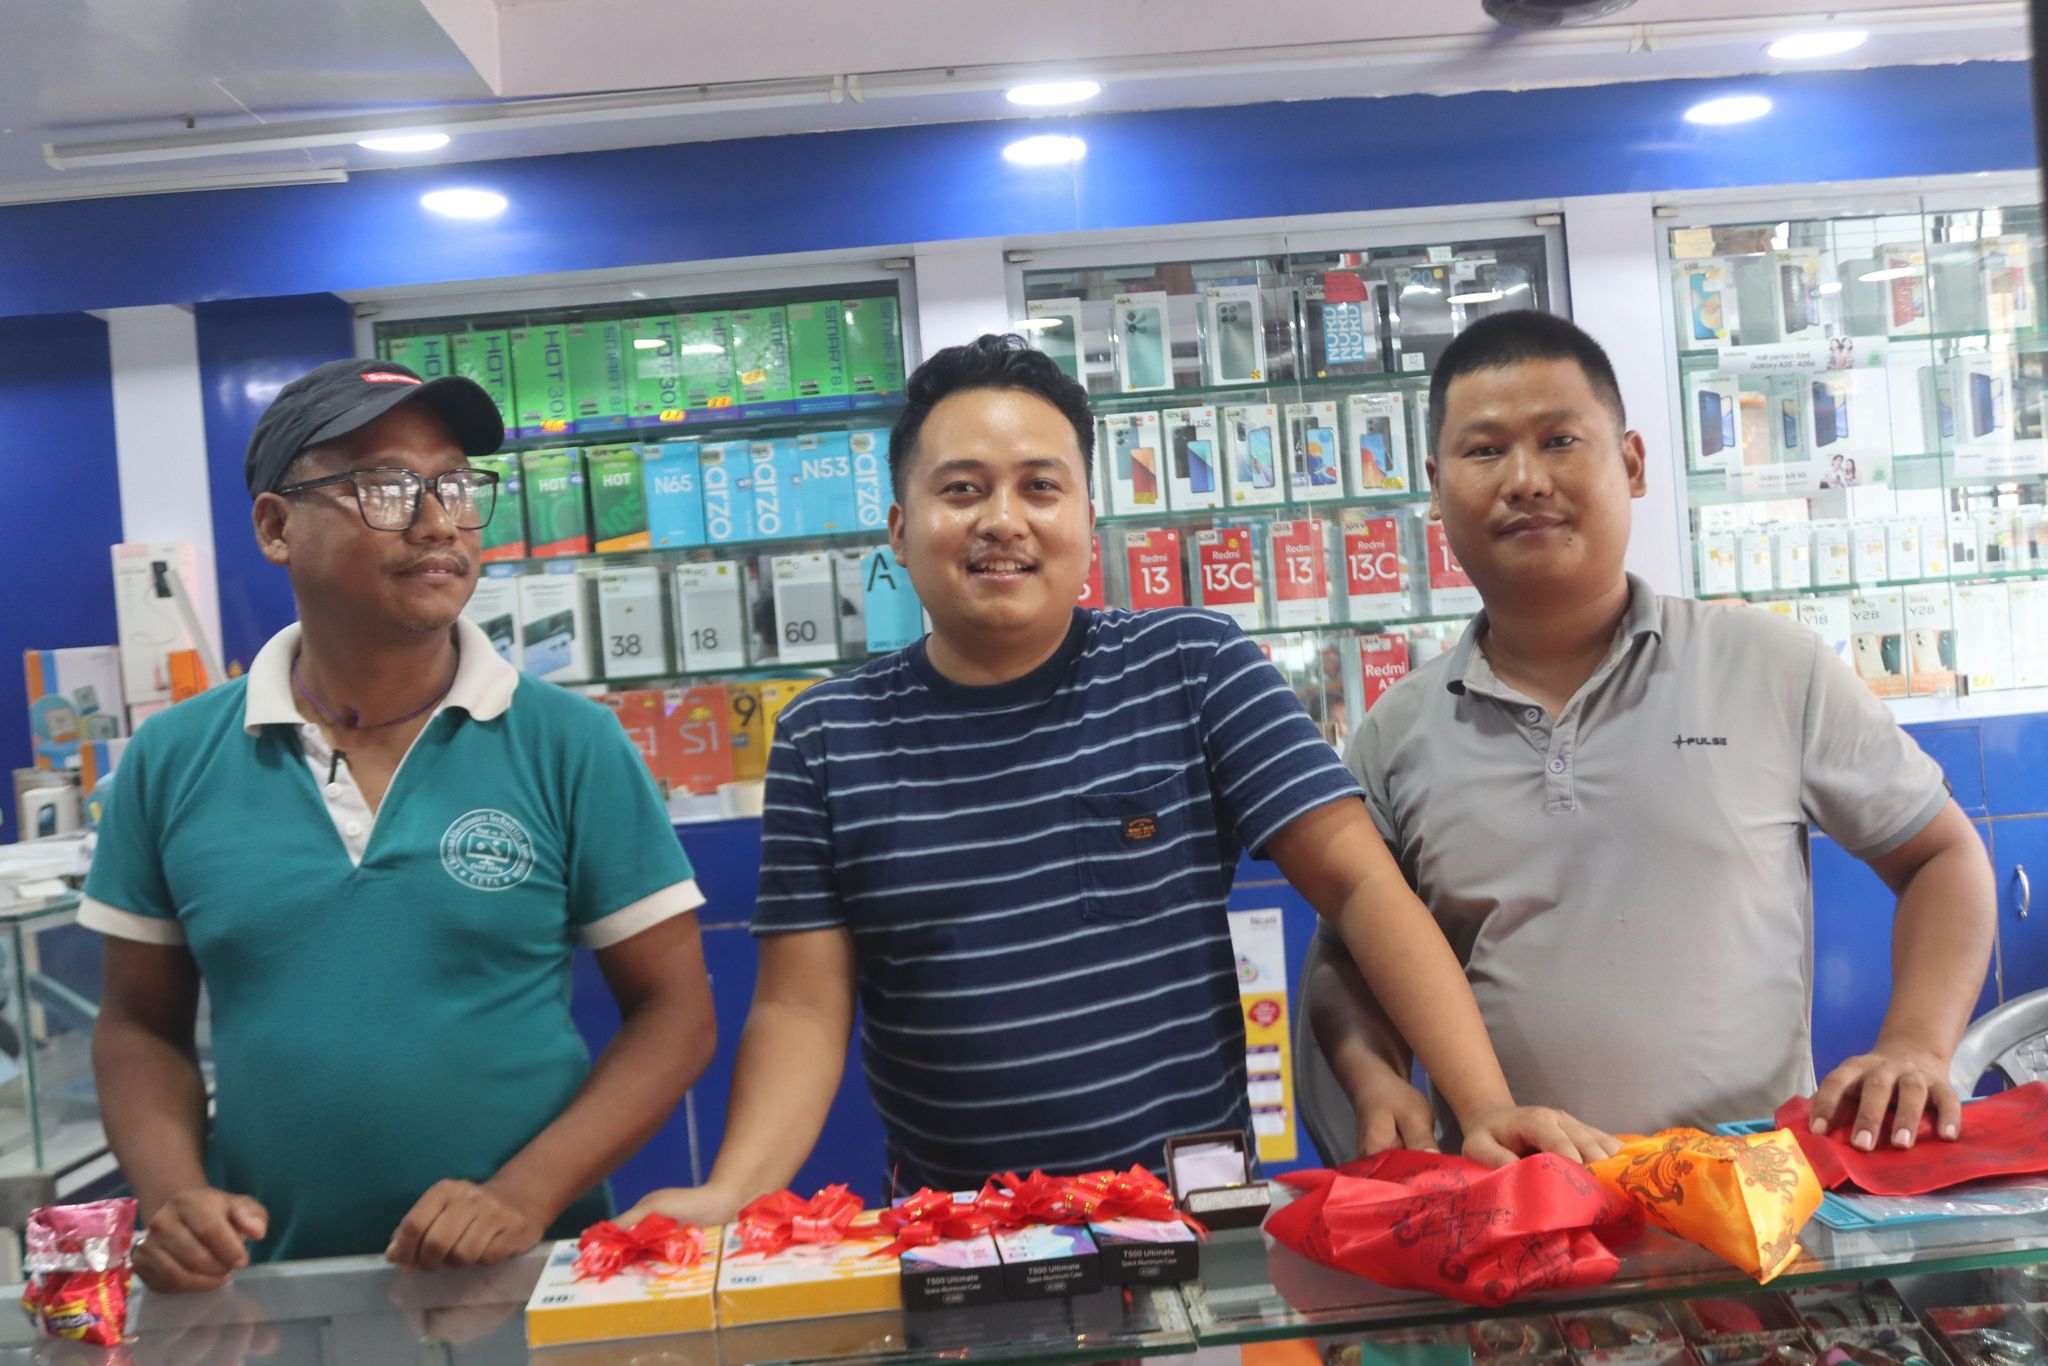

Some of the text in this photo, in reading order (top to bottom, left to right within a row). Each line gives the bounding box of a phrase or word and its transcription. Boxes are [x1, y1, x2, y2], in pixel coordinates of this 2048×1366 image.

[486, 335, 504, 384] HOT
[544, 330, 564, 381] HOT
[801, 456, 849, 480] N53
[538, 477, 568, 491] HOT
[603, 472, 632, 487] HOT
[654, 474, 693, 494] N65
[1212, 549, 1240, 559] Redmi
[1358, 539, 1385, 550] Redmi
[1140, 553, 1168, 563] Redmi
[1349, 552, 1398, 581] 13C
[867, 553, 896, 591] A
[1141, 566, 1170, 594] 13
[1203, 562, 1252, 591] 13C
[1286, 556, 1313, 584] 13
[690, 628, 718, 650] 18
[785, 621, 816, 643] 60
[611, 634, 641, 657] 38
[1365, 661, 1406, 678] Redmi
[679, 720, 719, 755] S1
[1144, 1248, 1175, 1258] Ultimate
[946, 1274, 979, 1284] Ultimate
[1048, 1264, 1080, 1273] Ultimate
